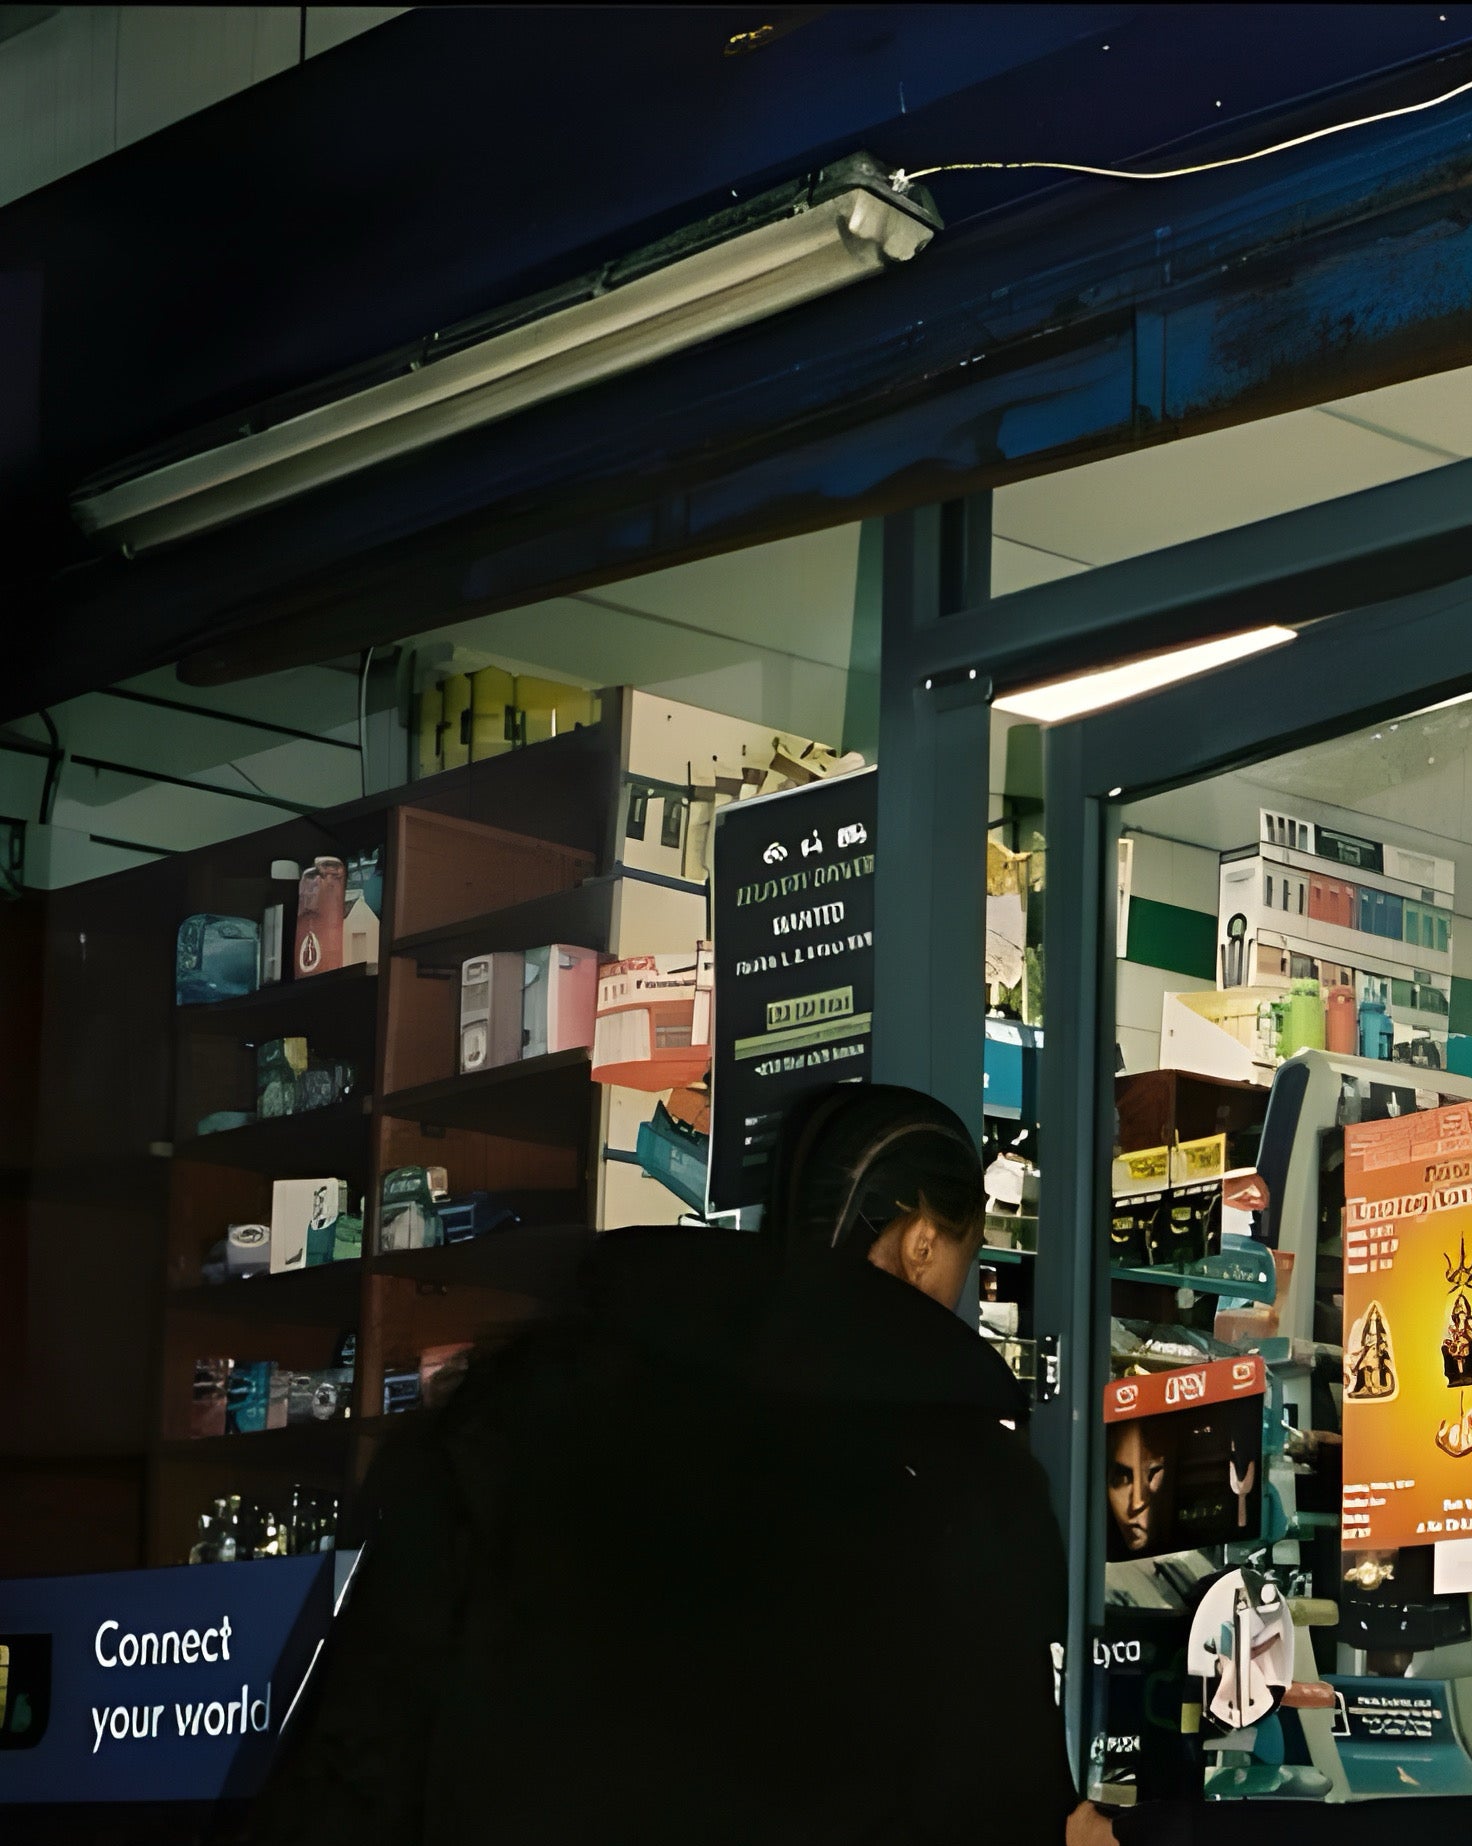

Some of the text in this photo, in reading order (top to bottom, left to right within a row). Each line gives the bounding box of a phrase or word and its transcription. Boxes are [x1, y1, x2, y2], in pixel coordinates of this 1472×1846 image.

[95, 1616, 232, 1668] Connect
[92, 1681, 272, 1754] your world
